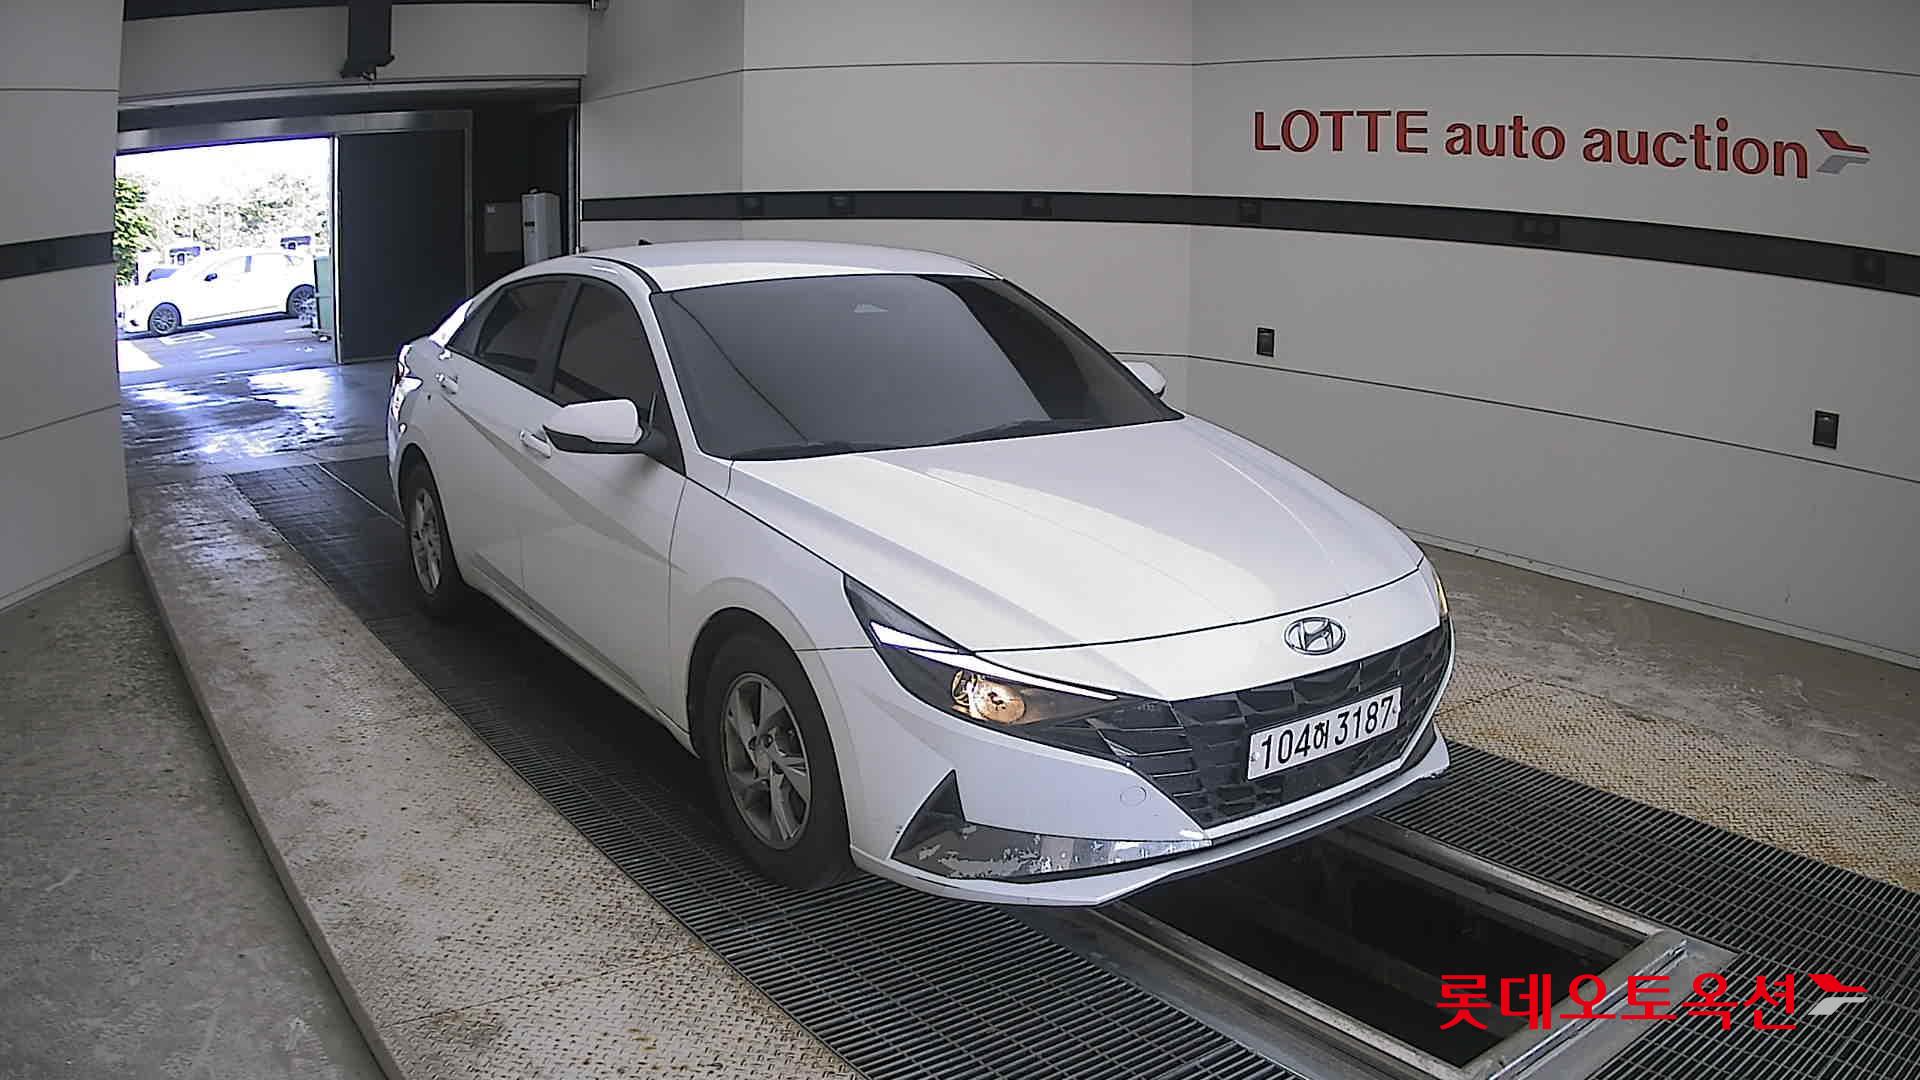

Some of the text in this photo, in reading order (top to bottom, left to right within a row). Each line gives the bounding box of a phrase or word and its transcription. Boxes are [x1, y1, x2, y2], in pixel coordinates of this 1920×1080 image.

[1255, 110, 1808, 179] LOTTE auto auction
[1335, 696, 1394, 745] 3187
